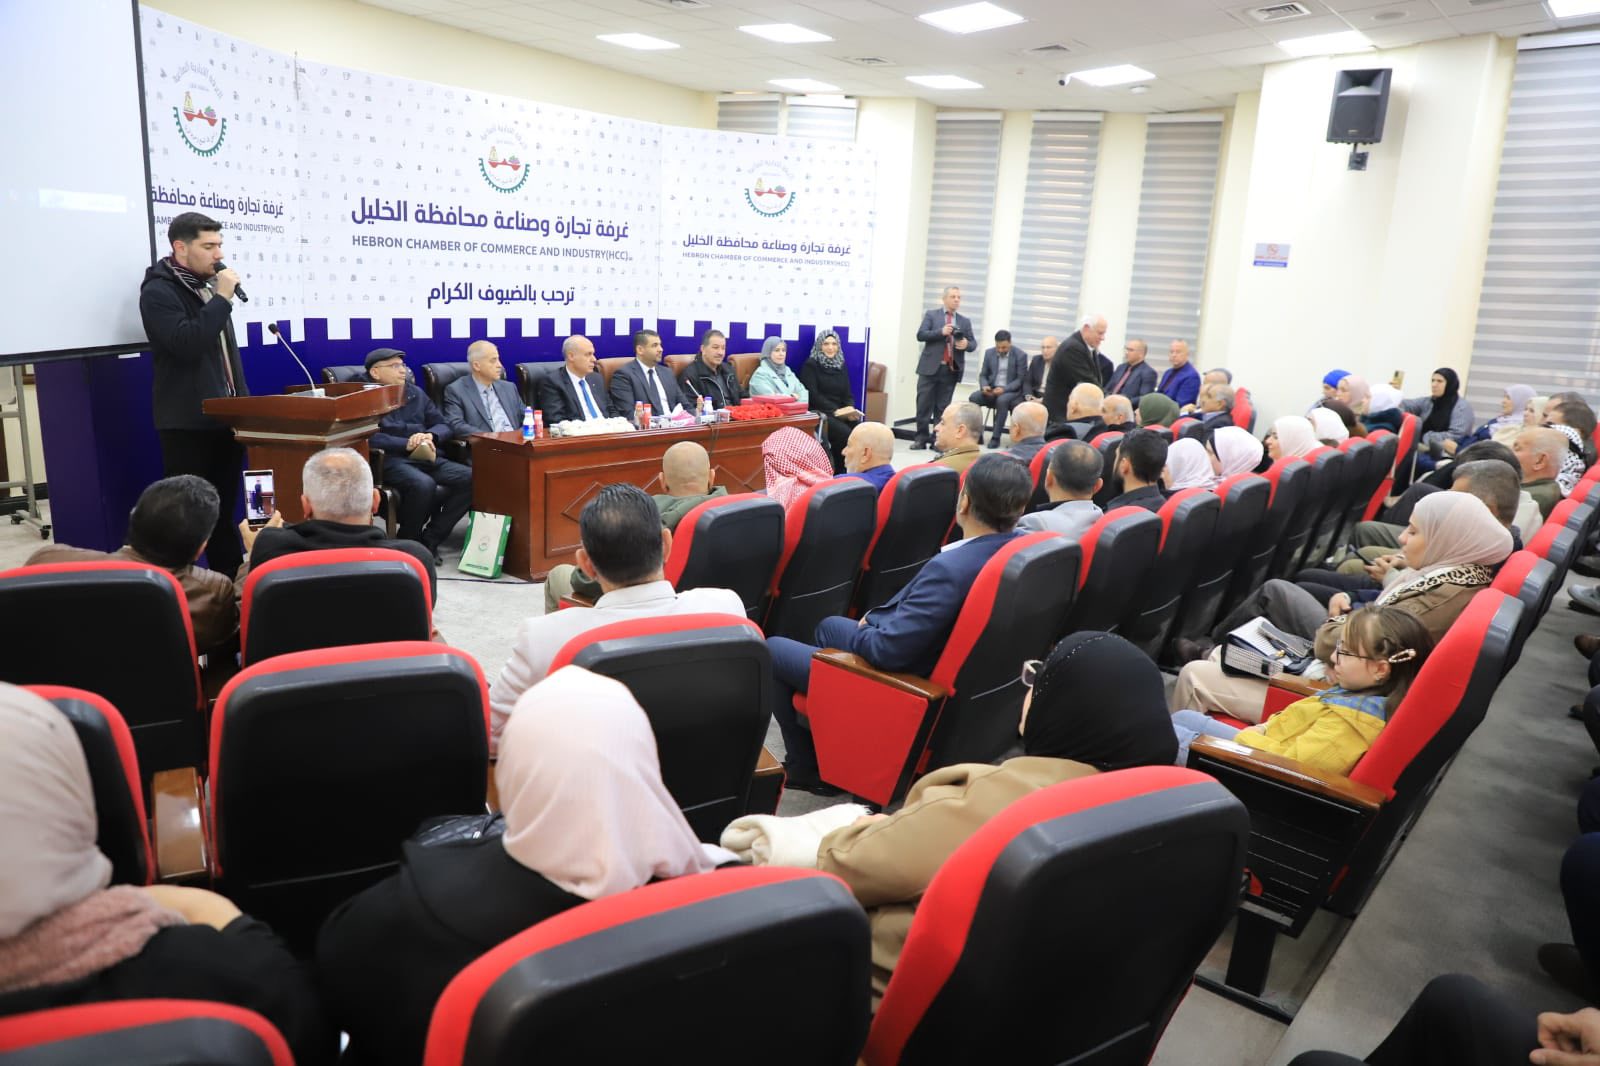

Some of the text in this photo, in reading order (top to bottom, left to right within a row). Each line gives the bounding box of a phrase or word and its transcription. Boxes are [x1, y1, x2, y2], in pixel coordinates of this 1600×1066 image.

[151, 185, 284, 219] غرفة تجارة وصناعة محافظة
[229, 222, 242, 231] AND
[351, 196, 629, 242] غرفة تجارة وصناعة محافظة الخليل
[352, 234, 403, 249] HEBRON
[406, 238, 461, 252] CHAMBER
[463, 242, 478, 252] OF
[480, 242, 537, 256] COMMERCE
[539, 246, 560, 257] AND
[682, 233, 851, 257] غرفة تجارة وصناعة محافظة الخليل
[427, 281, 575, 309] ترحب بالضيوف الكرام
